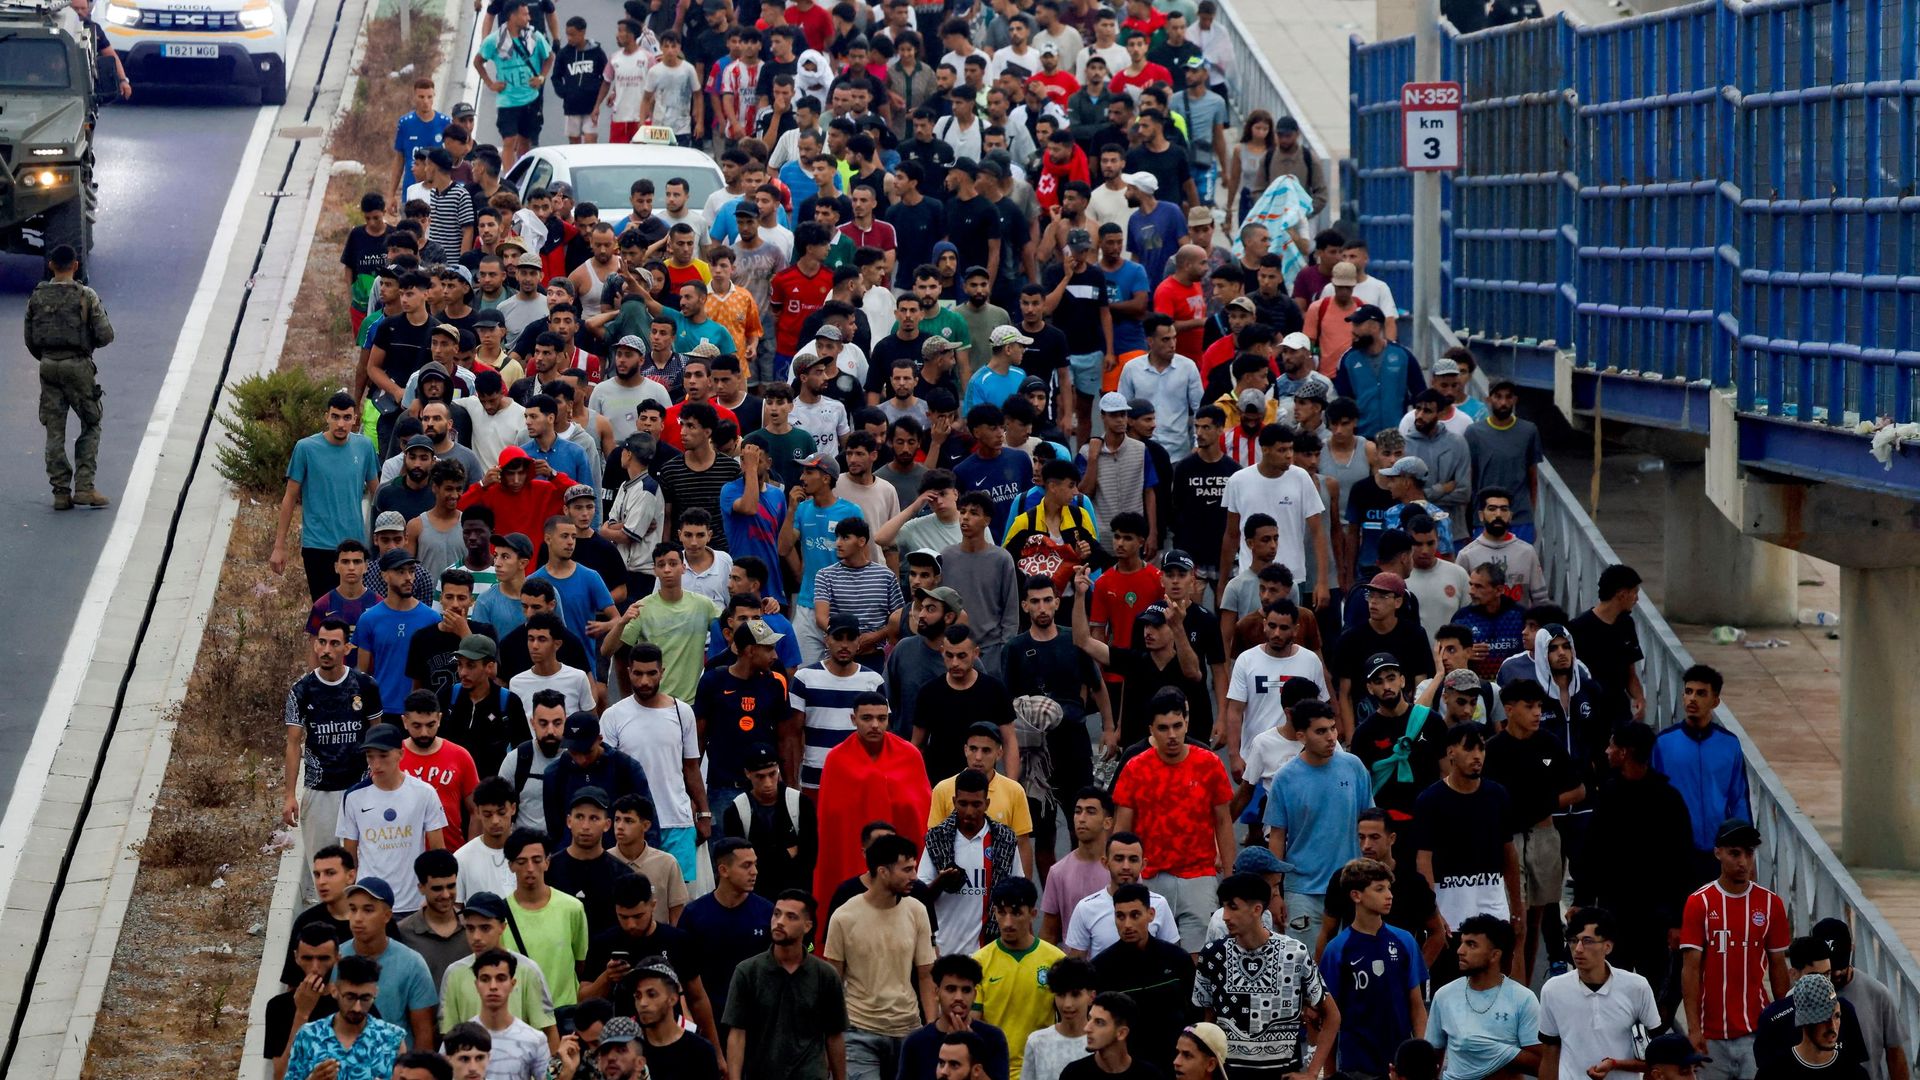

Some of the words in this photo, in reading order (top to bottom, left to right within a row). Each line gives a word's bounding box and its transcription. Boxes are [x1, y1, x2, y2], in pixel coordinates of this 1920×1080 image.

[169, 46, 193, 56] 1821
[196, 46, 216, 56] MGG
[567, 60, 594, 76] VANS
[1405, 87, 1459, 105] N-352
[1420, 117, 1444, 129] km
[650, 129, 669, 140] TAXI
[1423, 137, 1441, 160] 3
[1189, 477, 1203, 486] ICI
[310, 720, 363, 735] Emirates
[318, 735, 330, 745] FLY
[332, 732, 357, 744] BETTER
[365, 824, 413, 841] QATAR
[1352, 970, 1369, 991] 10
